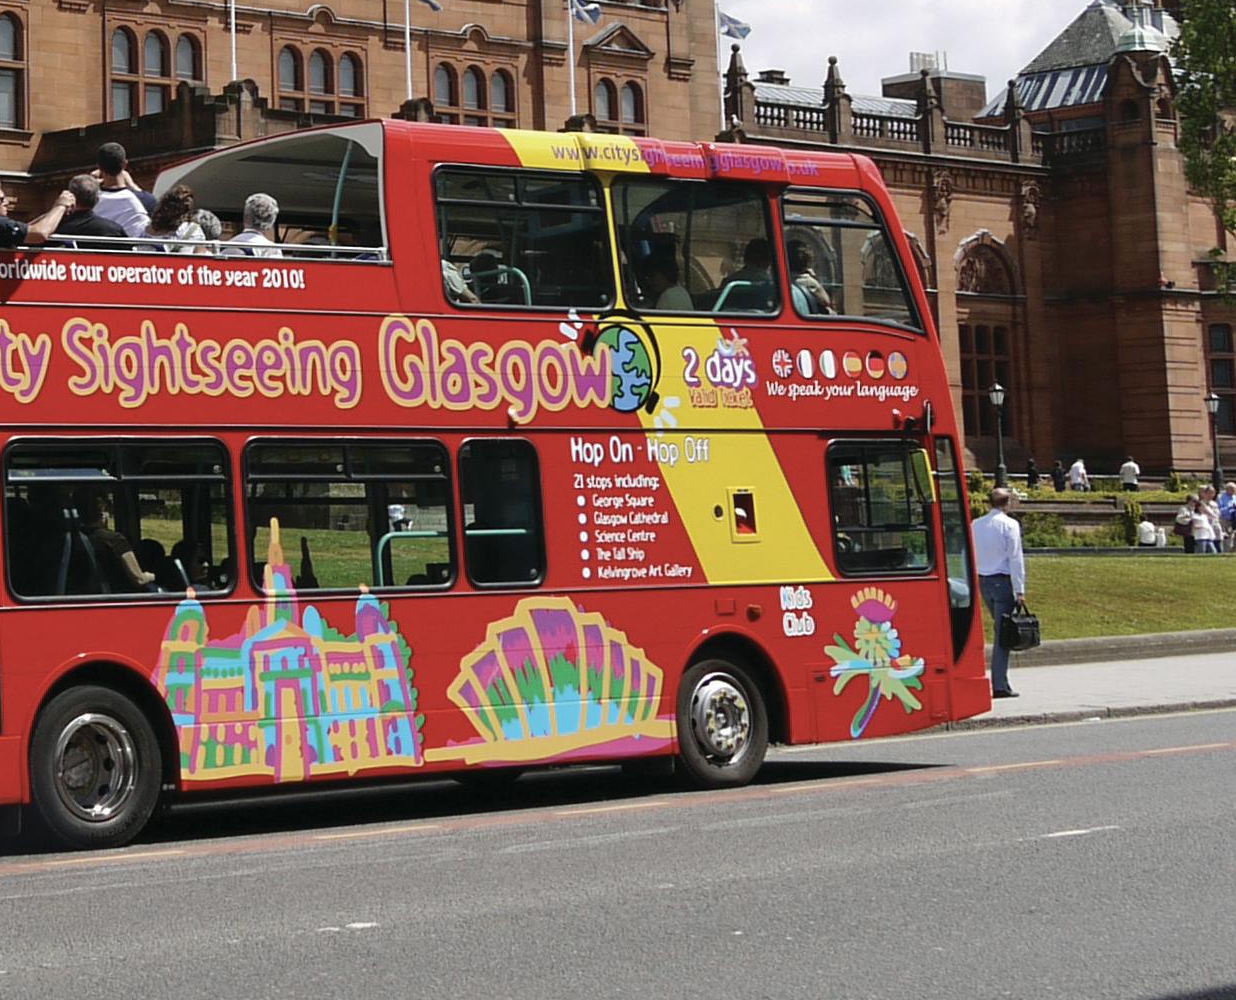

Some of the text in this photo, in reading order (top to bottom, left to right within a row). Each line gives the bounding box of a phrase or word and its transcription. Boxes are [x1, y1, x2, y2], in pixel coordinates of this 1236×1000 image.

[69, 262, 104, 283] tour
[108, 265, 174, 285] operator
[177, 265, 195, 286] of
[197, 265, 222, 286] the
[225, 269, 259, 289] year
[262, 268, 306, 289] 2010!
[62, 317, 362, 409] Sightseeing
[378, 313, 613, 425] Glasgow
[682, 347, 758, 388] 2 days
[766, 380, 918, 401] We speak your language
[570, 436, 604, 467] Hop
[609, 435, 633, 463] On
[647, 437, 679, 467] Hop
[685, 436, 710, 463] Off
[573, 473, 660, 491] 21 stops including:
[592, 494, 655, 509] George Square
[593, 511, 669, 527] Glasgow Cathedral
[594, 529, 656, 543] Science Centre
[596, 547, 646, 562] The Tall Ship
[597, 564, 693, 580] Kelvingrove Art Gallery
[780, 586, 815, 637] Kids Club
